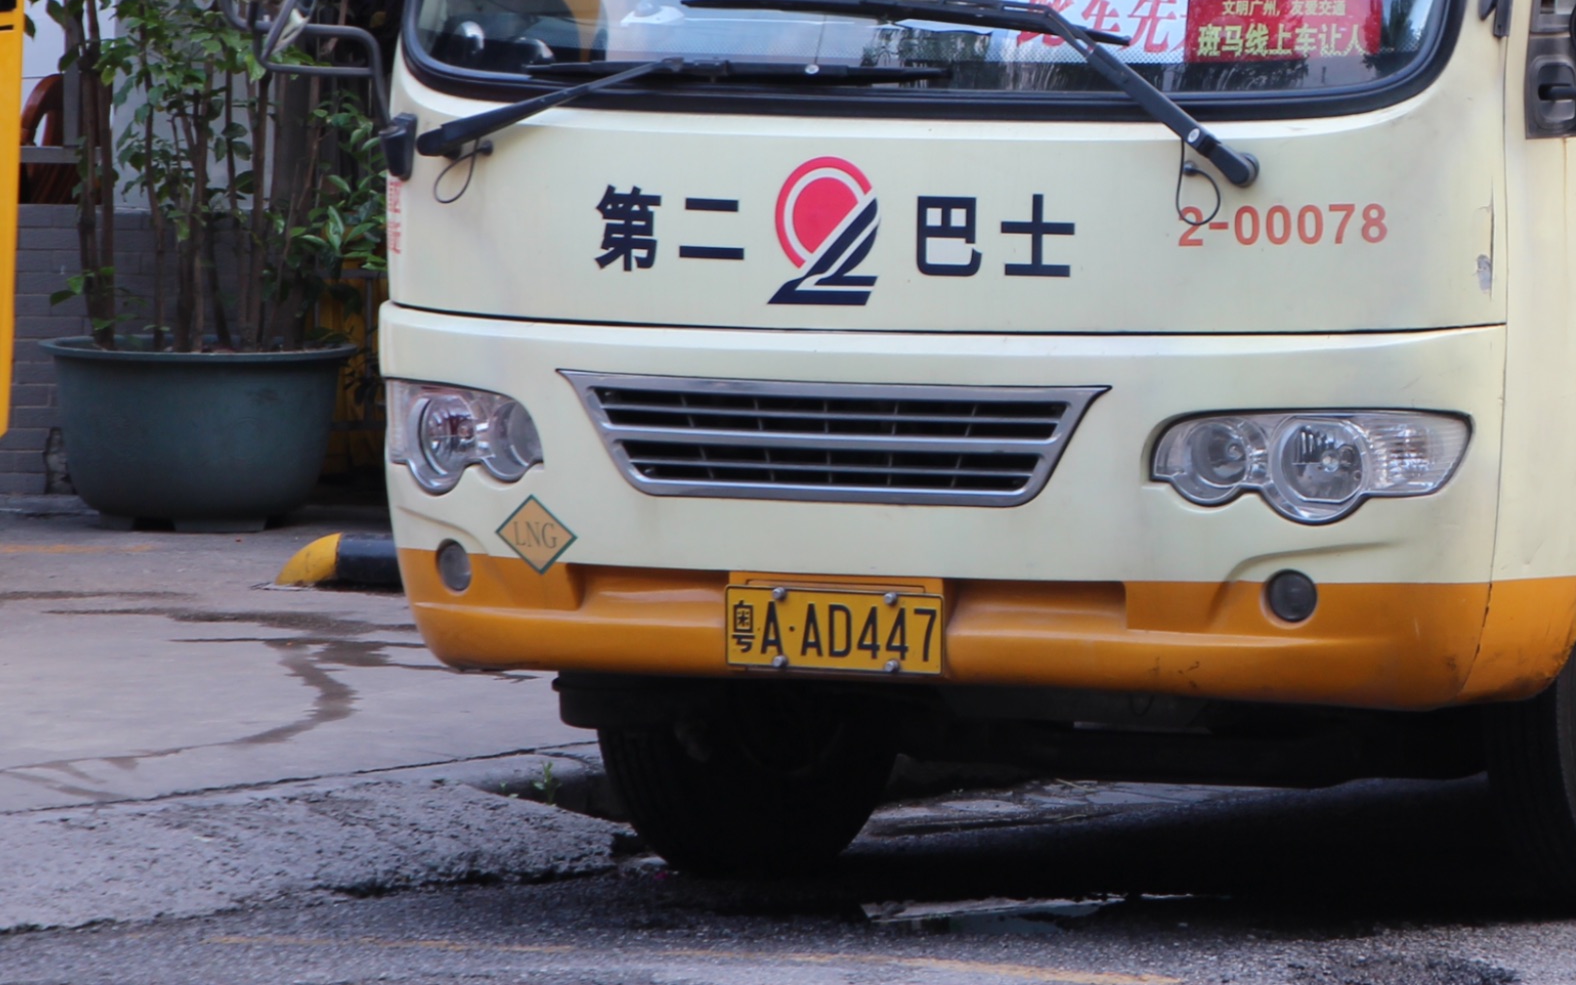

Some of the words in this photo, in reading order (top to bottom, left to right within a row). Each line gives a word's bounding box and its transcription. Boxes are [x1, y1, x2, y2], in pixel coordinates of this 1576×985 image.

[1197, 23, 1367, 58] 斑马线上车让人
[594, 184, 746, 272] 第二
[916, 193, 1076, 278] 巴士
[1177, 203, 1388, 247] 2-00078
[513, 520, 559, 549] LNG
